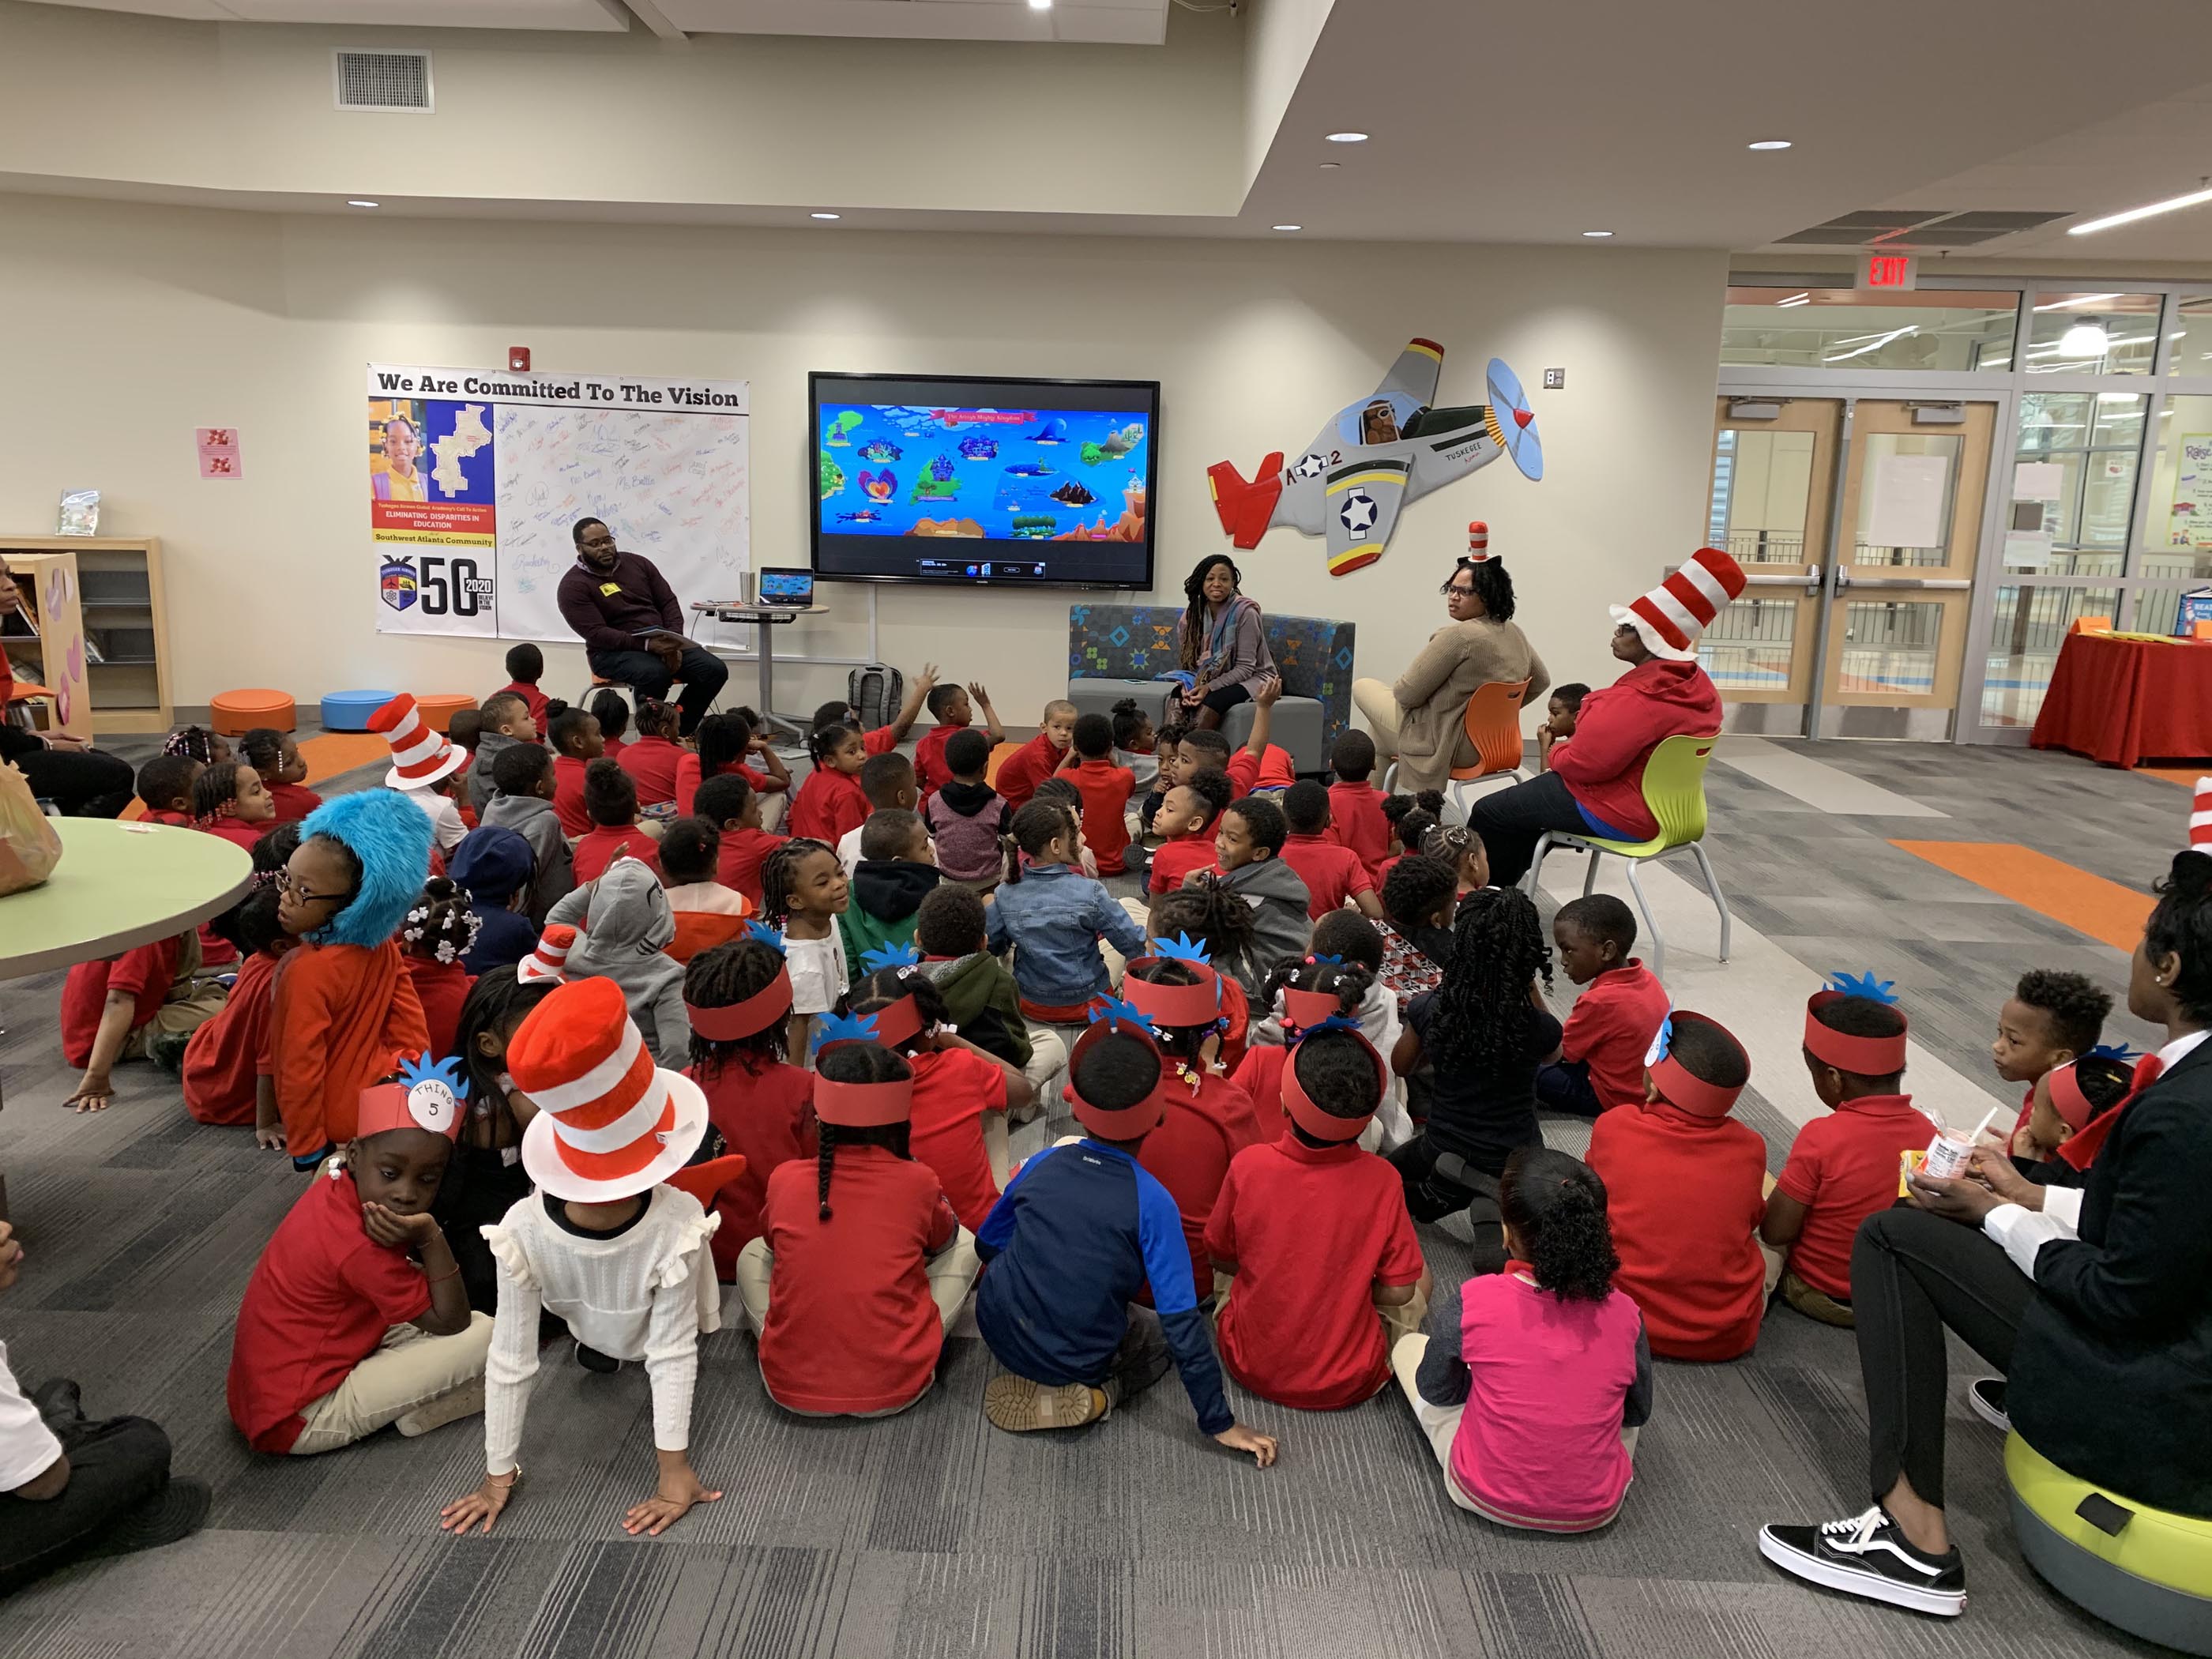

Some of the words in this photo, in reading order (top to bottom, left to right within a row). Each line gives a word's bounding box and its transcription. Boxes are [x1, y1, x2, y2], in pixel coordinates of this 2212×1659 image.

[1869, 257, 1909, 287] EXIT
[378, 373, 412, 391] We
[419, 375, 458, 393] Are
[464, 378, 581, 399] Committed
[586, 383, 614, 401] To
[620, 385, 662, 403] The
[668, 387, 739, 407] Vision
[1330, 450, 1342, 465] 2
[1445, 442, 1482, 461] TUSKEGEE
[1285, 468, 1297, 486] A
[386, 511, 427, 520] ELIMINATING
[375, 533, 416, 542] Southwest
[446, 538, 493, 547] Community
[420, 557, 478, 616] 50
[465, 579, 491, 592] 2020
[415, 1084, 453, 1105] THING
[429, 1103, 439, 1115] 5
